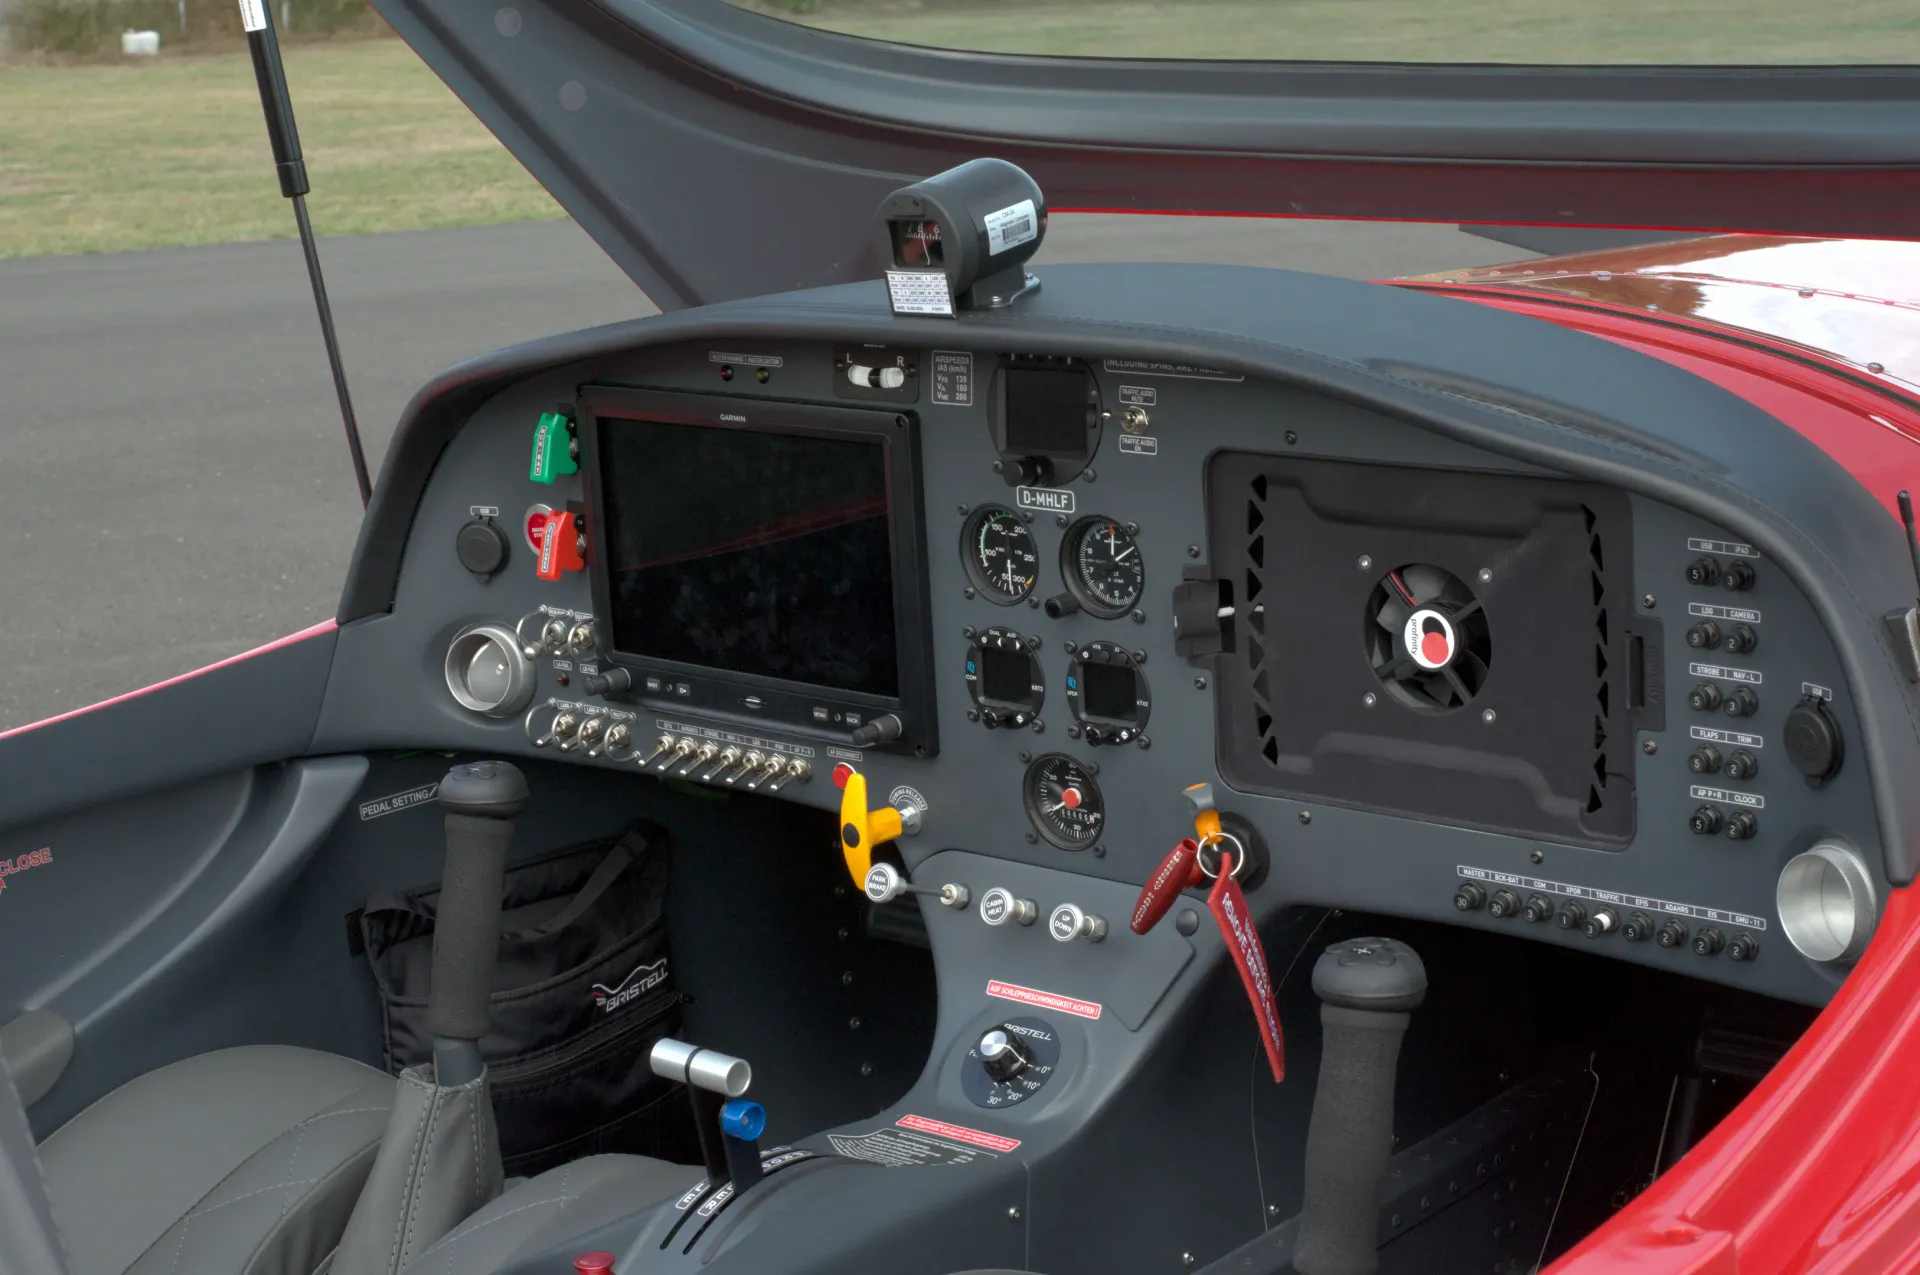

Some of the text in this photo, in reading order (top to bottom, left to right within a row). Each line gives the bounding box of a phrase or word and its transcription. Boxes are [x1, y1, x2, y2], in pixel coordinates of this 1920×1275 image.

[846, 352, 852, 364] L
[896, 356, 904, 366] R
[935, 356, 970, 365] AIRSPEEDS
[937, 364, 968, 374] IAS (km/h)
[956, 375, 968, 383] 139
[1122, 388, 1140, 396] TRAFFIC
[719, 414, 746, 424] GARMIN
[1122, 437, 1140, 446] TRAFFIC
[1023, 490, 1068, 508] D-MHLF
[1700, 542, 1713, 550] USB
[1692, 570, 1733, 586] 5 3
[1702, 607, 1755, 620] LDG CAMERA
[1410, 618, 1419, 656] profinity
[1693, 634, 1734, 648] 5 2
[1696, 666, 1720, 676] STROBE
[1031, 684, 1044, 692] KRT2
[1812, 687, 1822, 696] USB
[1694, 696, 1735, 712] 5 3
[813, 711, 859, 724] MENU BACK
[1700, 730, 1752, 744] FLAPS TRIM
[836, 750, 860, 759] DISCONNECT
[1694, 759, 1736, 775] 5 2
[890, 788, 926, 809] TOWING RELEASE
[1698, 789, 1706, 797] AP
[1734, 794, 1757, 804] CLOCK
[362, 790, 429, 817] PEDAL SETTING
[1696, 820, 1736, 835] 5 2
[0, 846, 54, 877] CLOSE
[872, 874, 887, 884] PARK
[868, 882, 888, 892] BRAKE
[1463, 868, 1486, 879] MASTER
[1494, 874, 1520, 884] BCK-BAT
[1534, 880, 1546, 890] COM
[1566, 886, 1582, 896] XPDR
[1596, 891, 1620, 902] TRAFFIC
[1636, 898, 1648, 908] EFIS
[1665, 903, 1689, 914] ADAHRS
[1708, 911, 1718, 920] EIS
[986, 900, 1004, 909] CABIN
[988, 907, 1004, 916] HEAT
[1062, 914, 1071, 922] UP
[1222, 892, 1248, 954] REMOVE
[1054, 920, 1072, 933] DOWN
[1458, 898, 1468, 908] 30
[1492, 904, 1501, 914] 30
[1528, 910, 1533, 919] 3
[1588, 926, 1593, 934] 3
[1628, 928, 1634, 938] 5
[1662, 934, 1668, 943] 2
[1698, 942, 1704, 951] 2
[1734, 946, 1739, 956] 2
[606, 967, 668, 1012] BRISTELL
[990, 984, 1001, 992] AUF
[1002, 986, 1072, 1010] SCHLEPPGESCHWINDIGKEIT
[1073, 1003, 1094, 1014] ACHTEN
[1004, 1023, 1052, 1041] BRISTELL
[1040, 1066, 1052, 1074] 0°
[1027, 1081, 1041, 1090] 10°
[986, 1096, 1002, 1104] 30°
[1008, 1092, 1022, 1100] 20°
